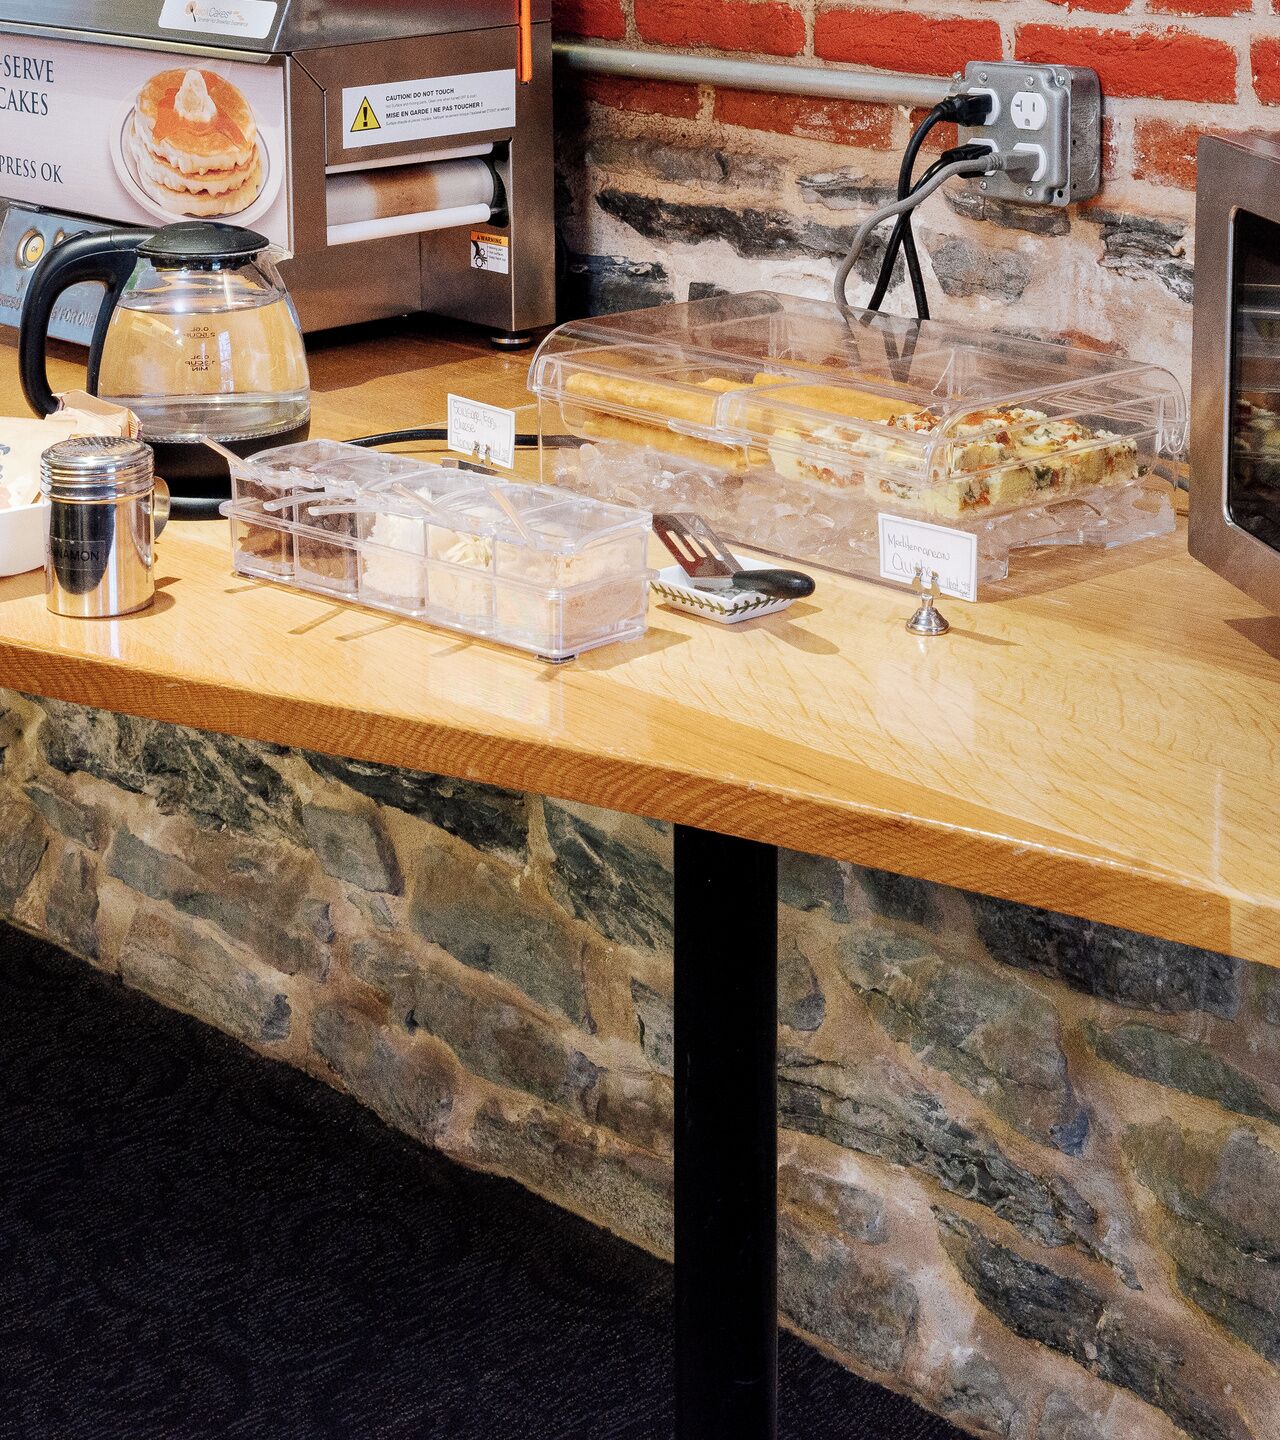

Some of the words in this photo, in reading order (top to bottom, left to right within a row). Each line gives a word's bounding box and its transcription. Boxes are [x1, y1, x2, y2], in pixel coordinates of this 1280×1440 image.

[385, 93, 412, 101] CAUTION!
[410, 108, 429, 116] GARDE
[454, 101, 480, 110] TOUCHER
[41, 162, 64, 184] OK
